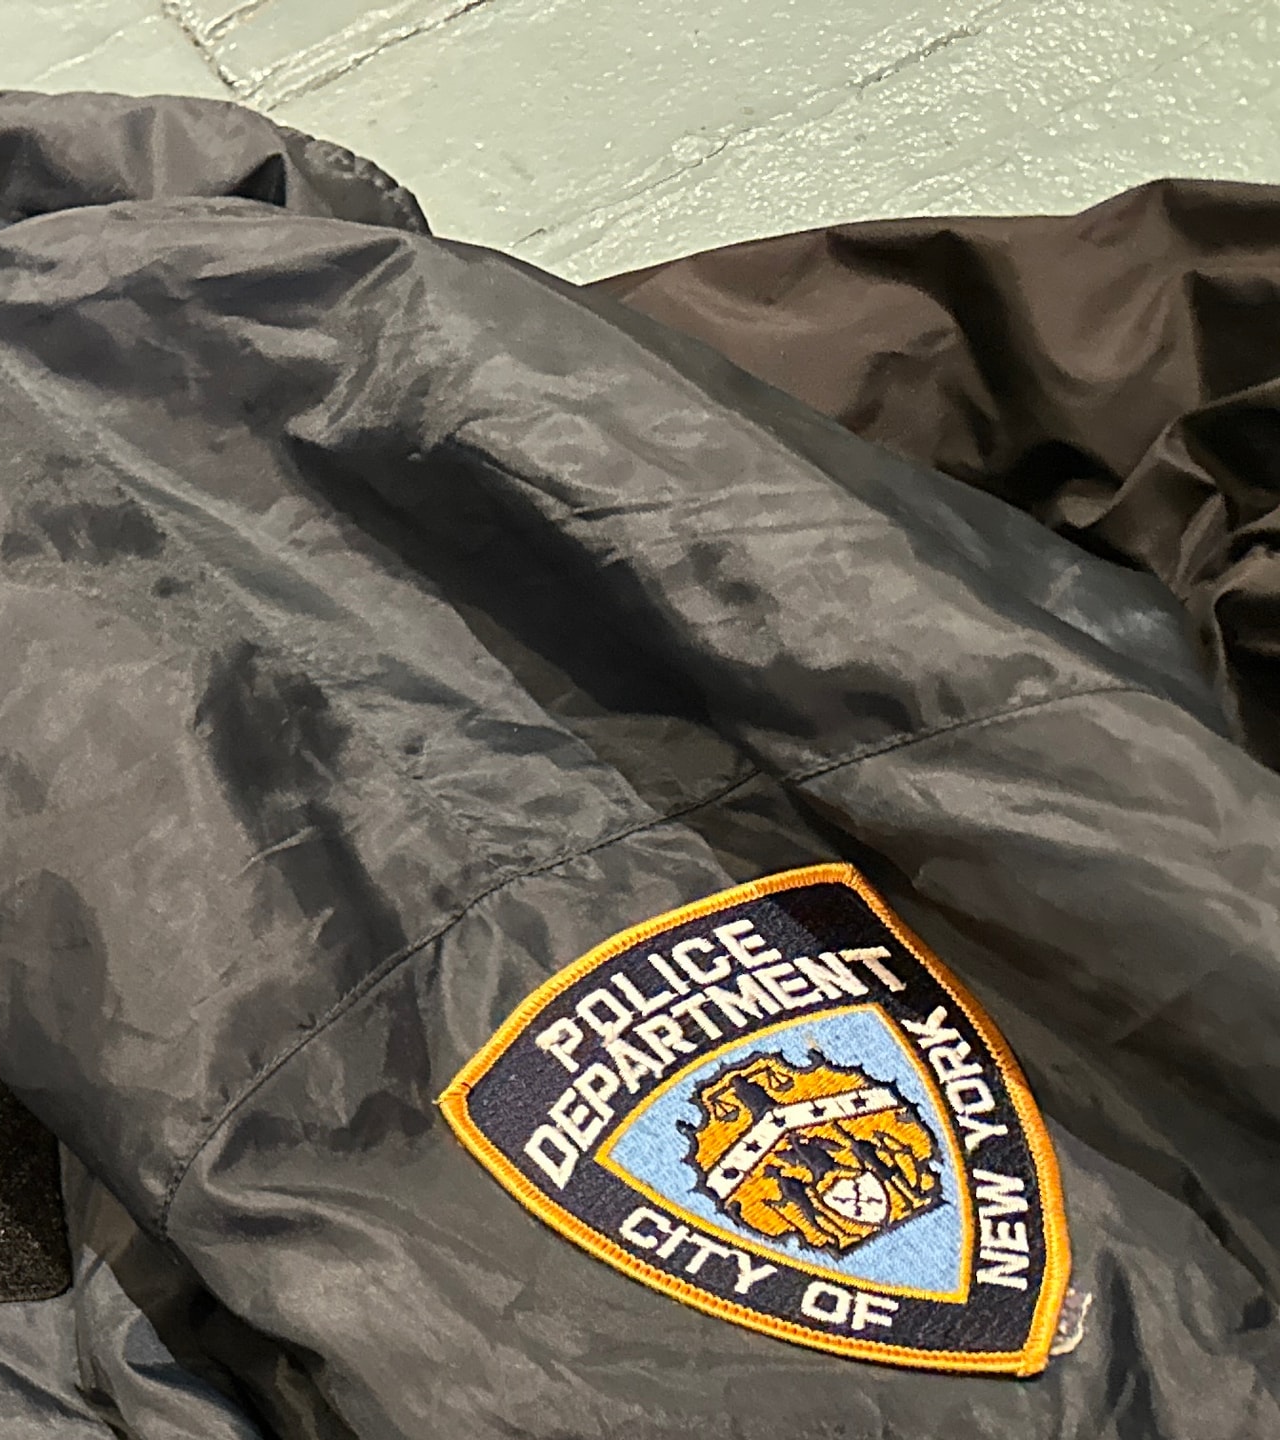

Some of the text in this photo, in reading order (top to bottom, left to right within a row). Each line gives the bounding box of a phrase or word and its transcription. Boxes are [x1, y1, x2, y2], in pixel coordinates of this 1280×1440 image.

[522, 945, 907, 1190] DEPARTMENT
[535, 918, 782, 1074] POLICE
[902, 1005, 1029, 1291] NEW YORK
[618, 1206, 899, 1331] CITY OF
